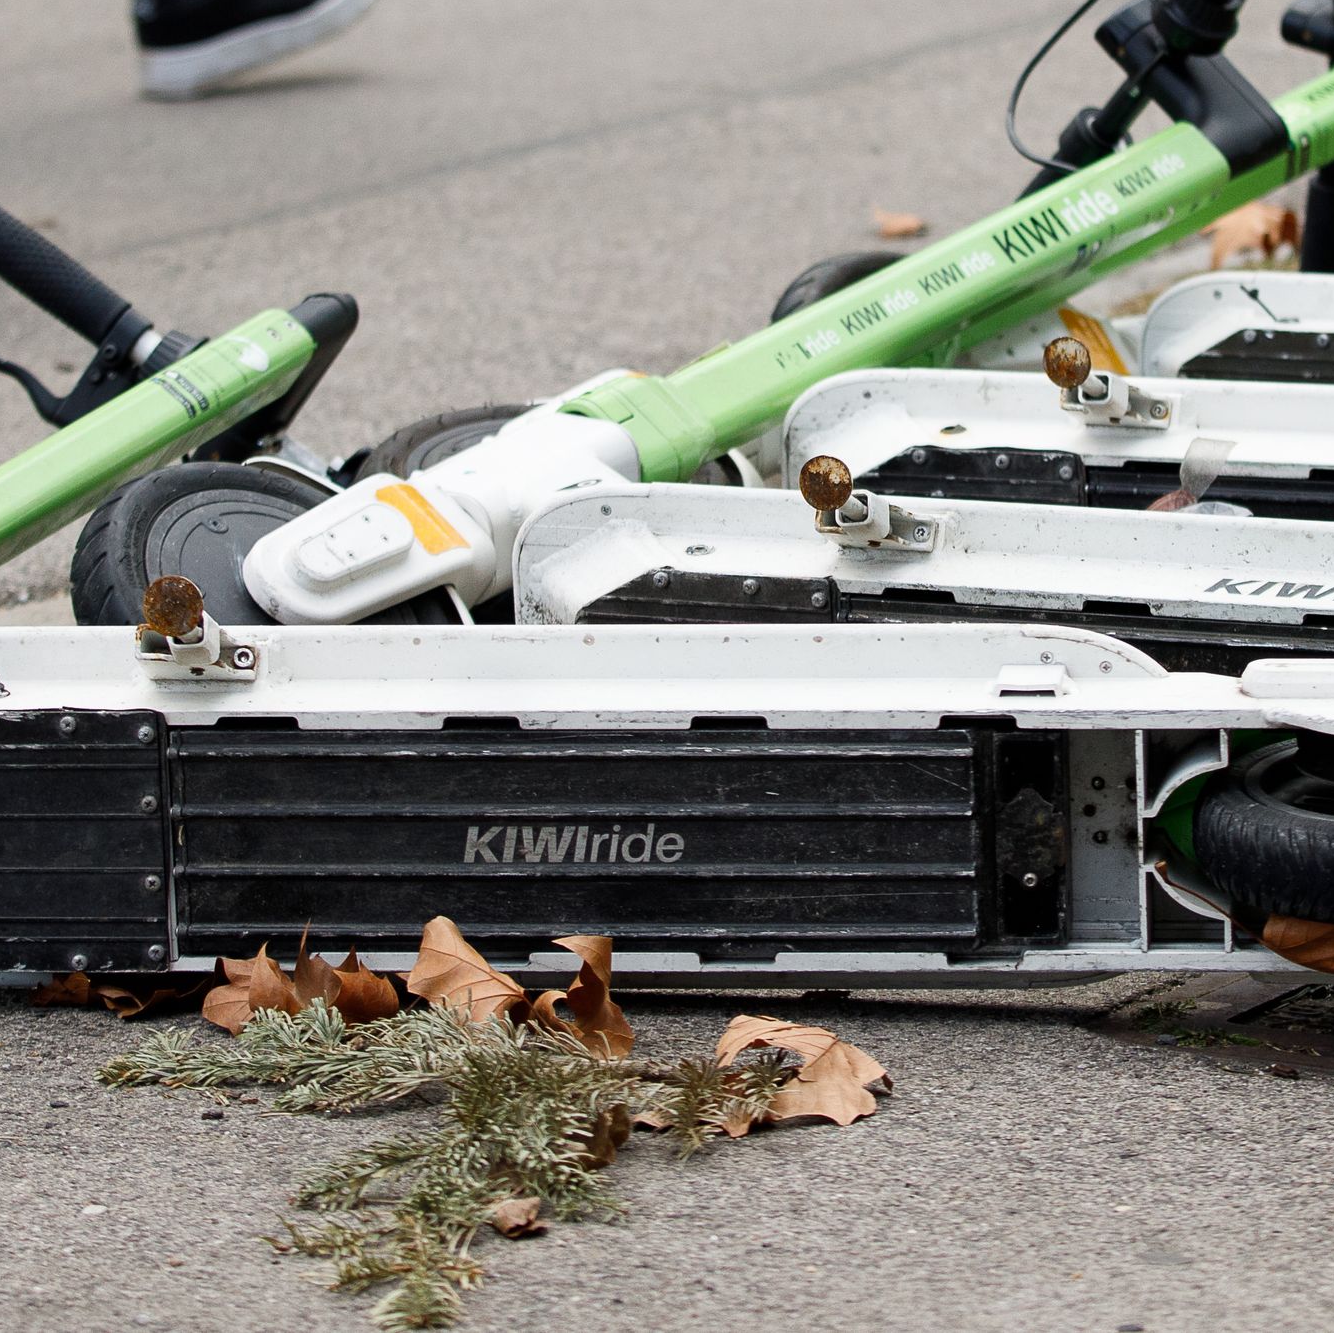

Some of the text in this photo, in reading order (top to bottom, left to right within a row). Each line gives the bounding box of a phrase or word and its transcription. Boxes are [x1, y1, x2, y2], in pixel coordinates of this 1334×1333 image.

[840, 287, 919, 336] KIWIride
[917, 249, 996, 296] KIWIride
[992, 188, 1119, 264] KIWIride
[1113, 153, 1186, 198] KIWIride
[463, 822, 685, 863] KIWIride
